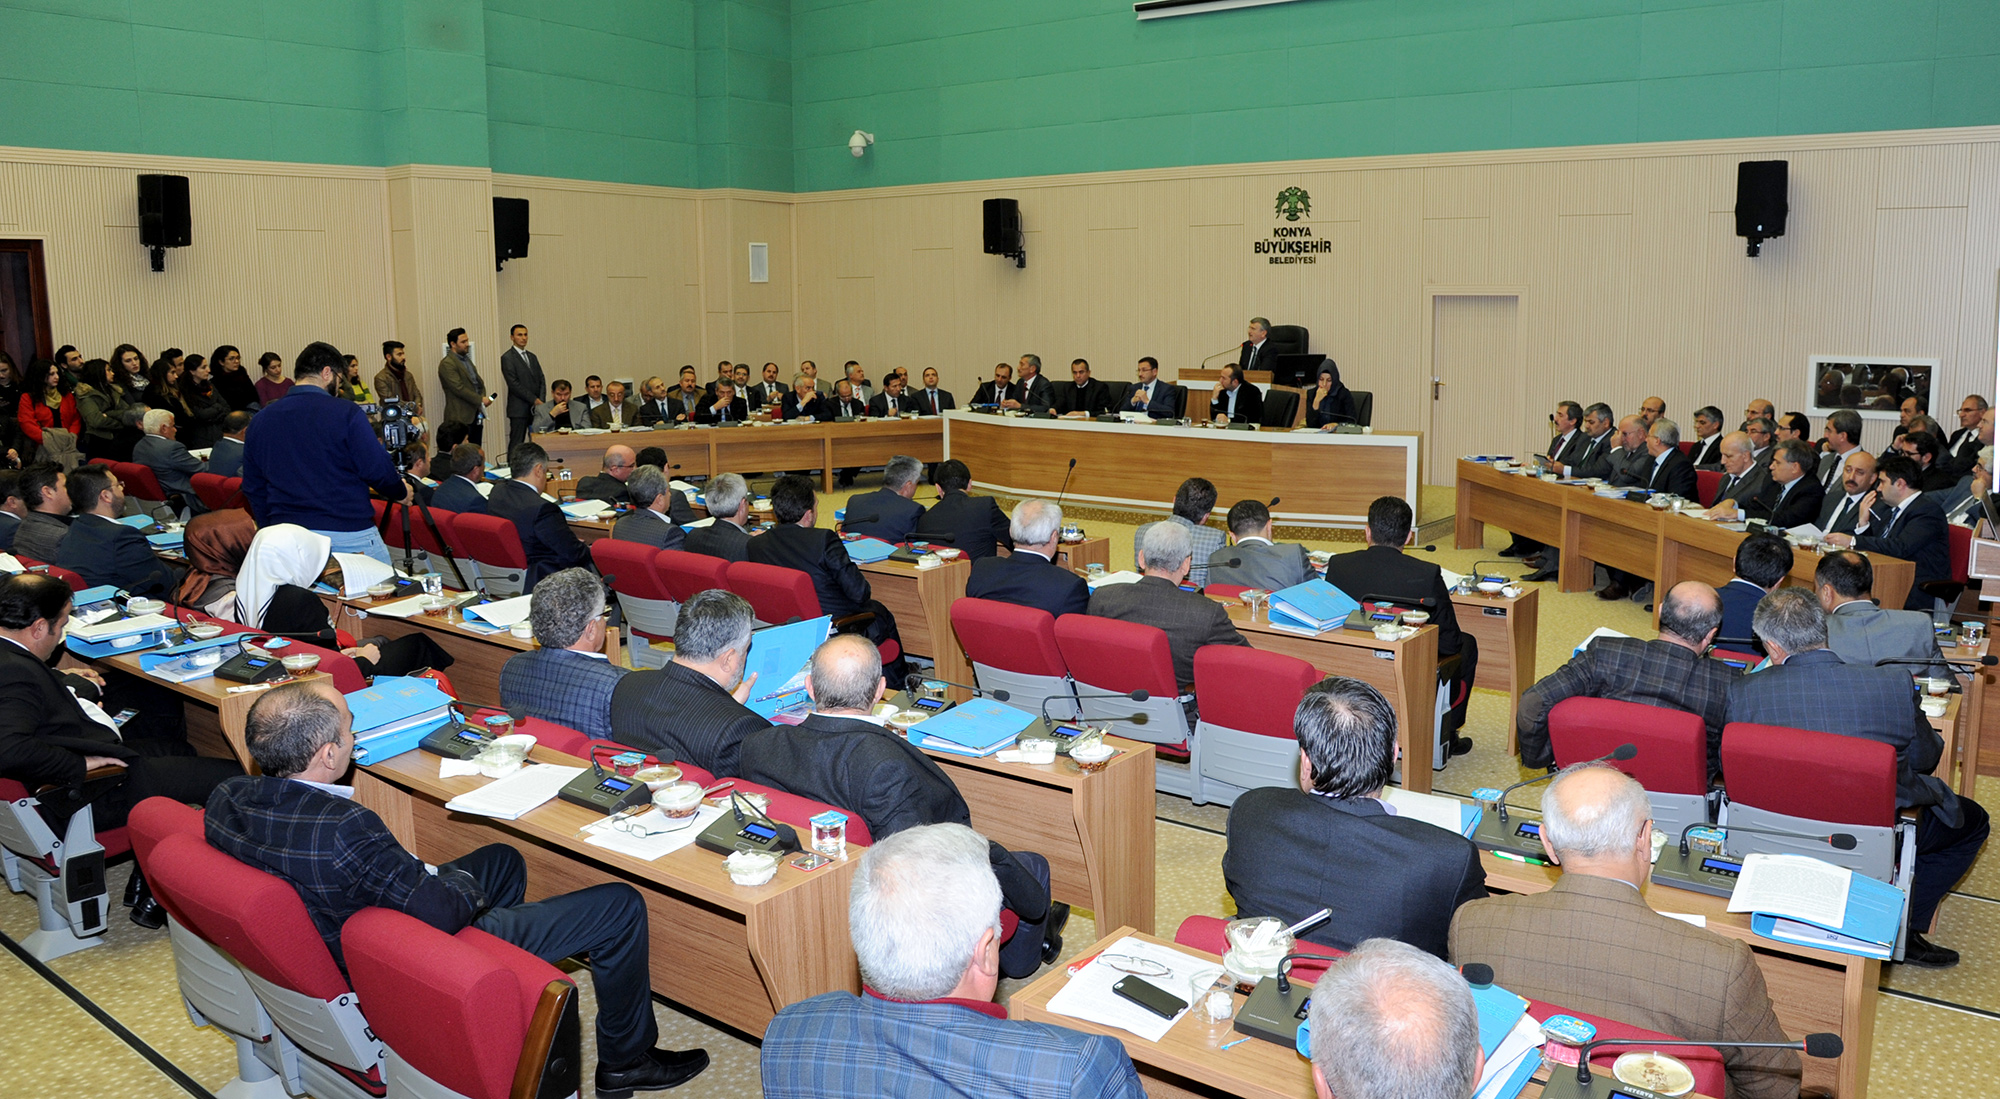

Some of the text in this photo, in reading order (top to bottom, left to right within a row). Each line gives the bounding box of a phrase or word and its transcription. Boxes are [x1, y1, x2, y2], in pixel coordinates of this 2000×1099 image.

[1273, 227, 1312, 237] KONYA
[1254, 238, 1332, 255] BÜYÜKŞEHİR
[1269, 255, 1316, 264] BELEDİYESİ
